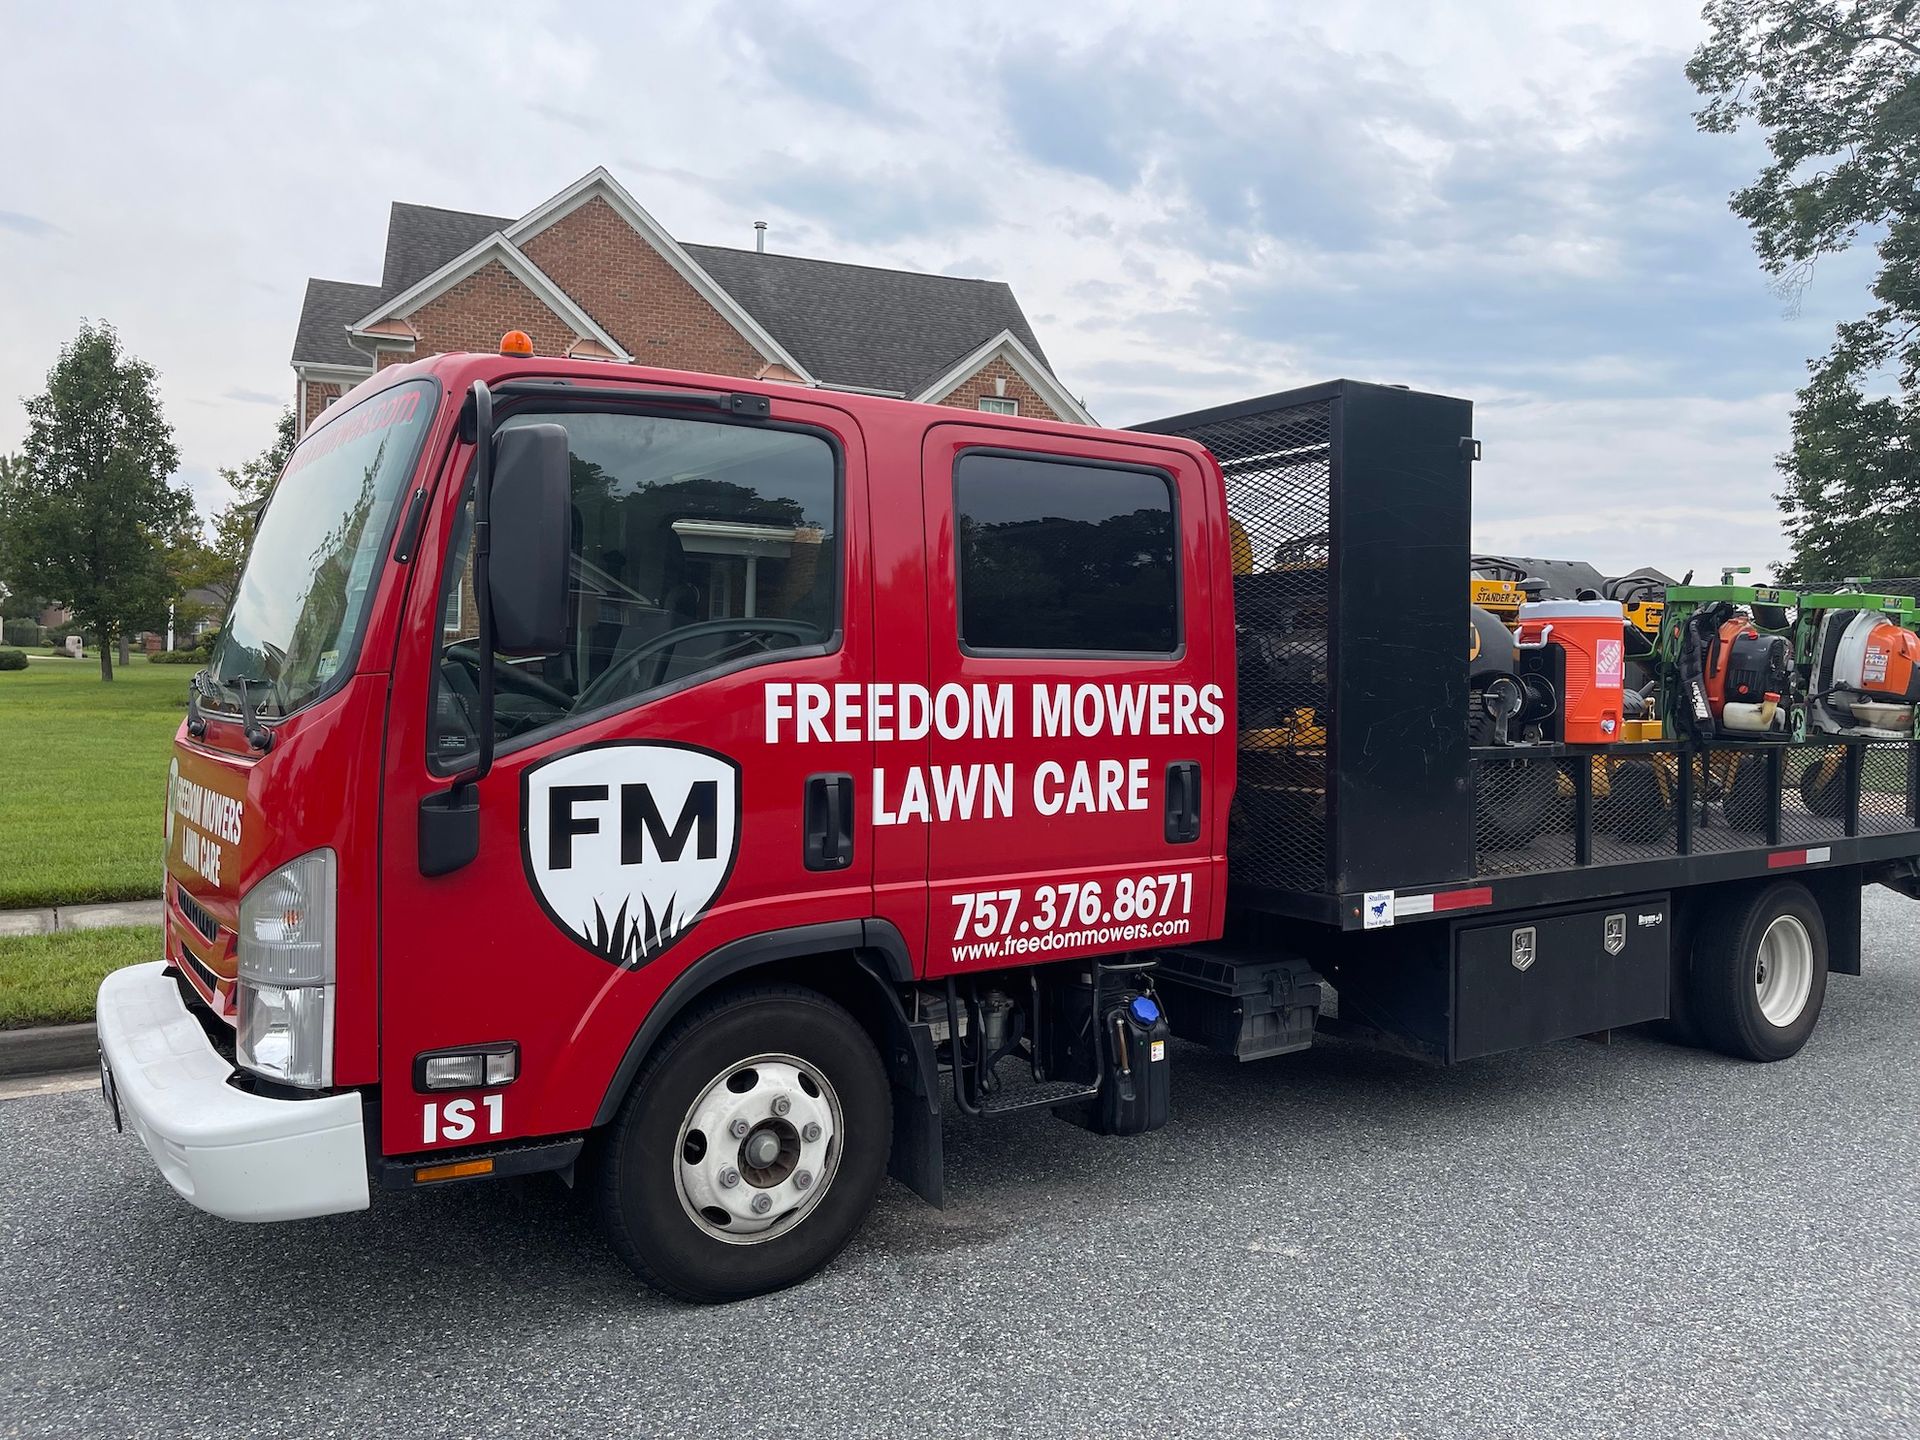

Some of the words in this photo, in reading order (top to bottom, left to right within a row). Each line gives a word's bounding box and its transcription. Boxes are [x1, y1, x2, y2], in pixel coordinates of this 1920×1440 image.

[1476, 592, 1510, 602] STANDER
[764, 683, 1013, 743] FREEDOM
[1032, 683, 1225, 736] MOWERS
[201, 787, 243, 846] MOWERS
[872, 763, 1014, 826] LAWN
[1033, 758, 1150, 816] CARE
[548, 780, 718, 871] FM
[183, 825, 200, 873] LAWN
[200, 836, 222, 888] CARE
[951, 873, 1194, 941] 757.376.8671
[951, 918, 1190, 963] www.freedommowers.com
